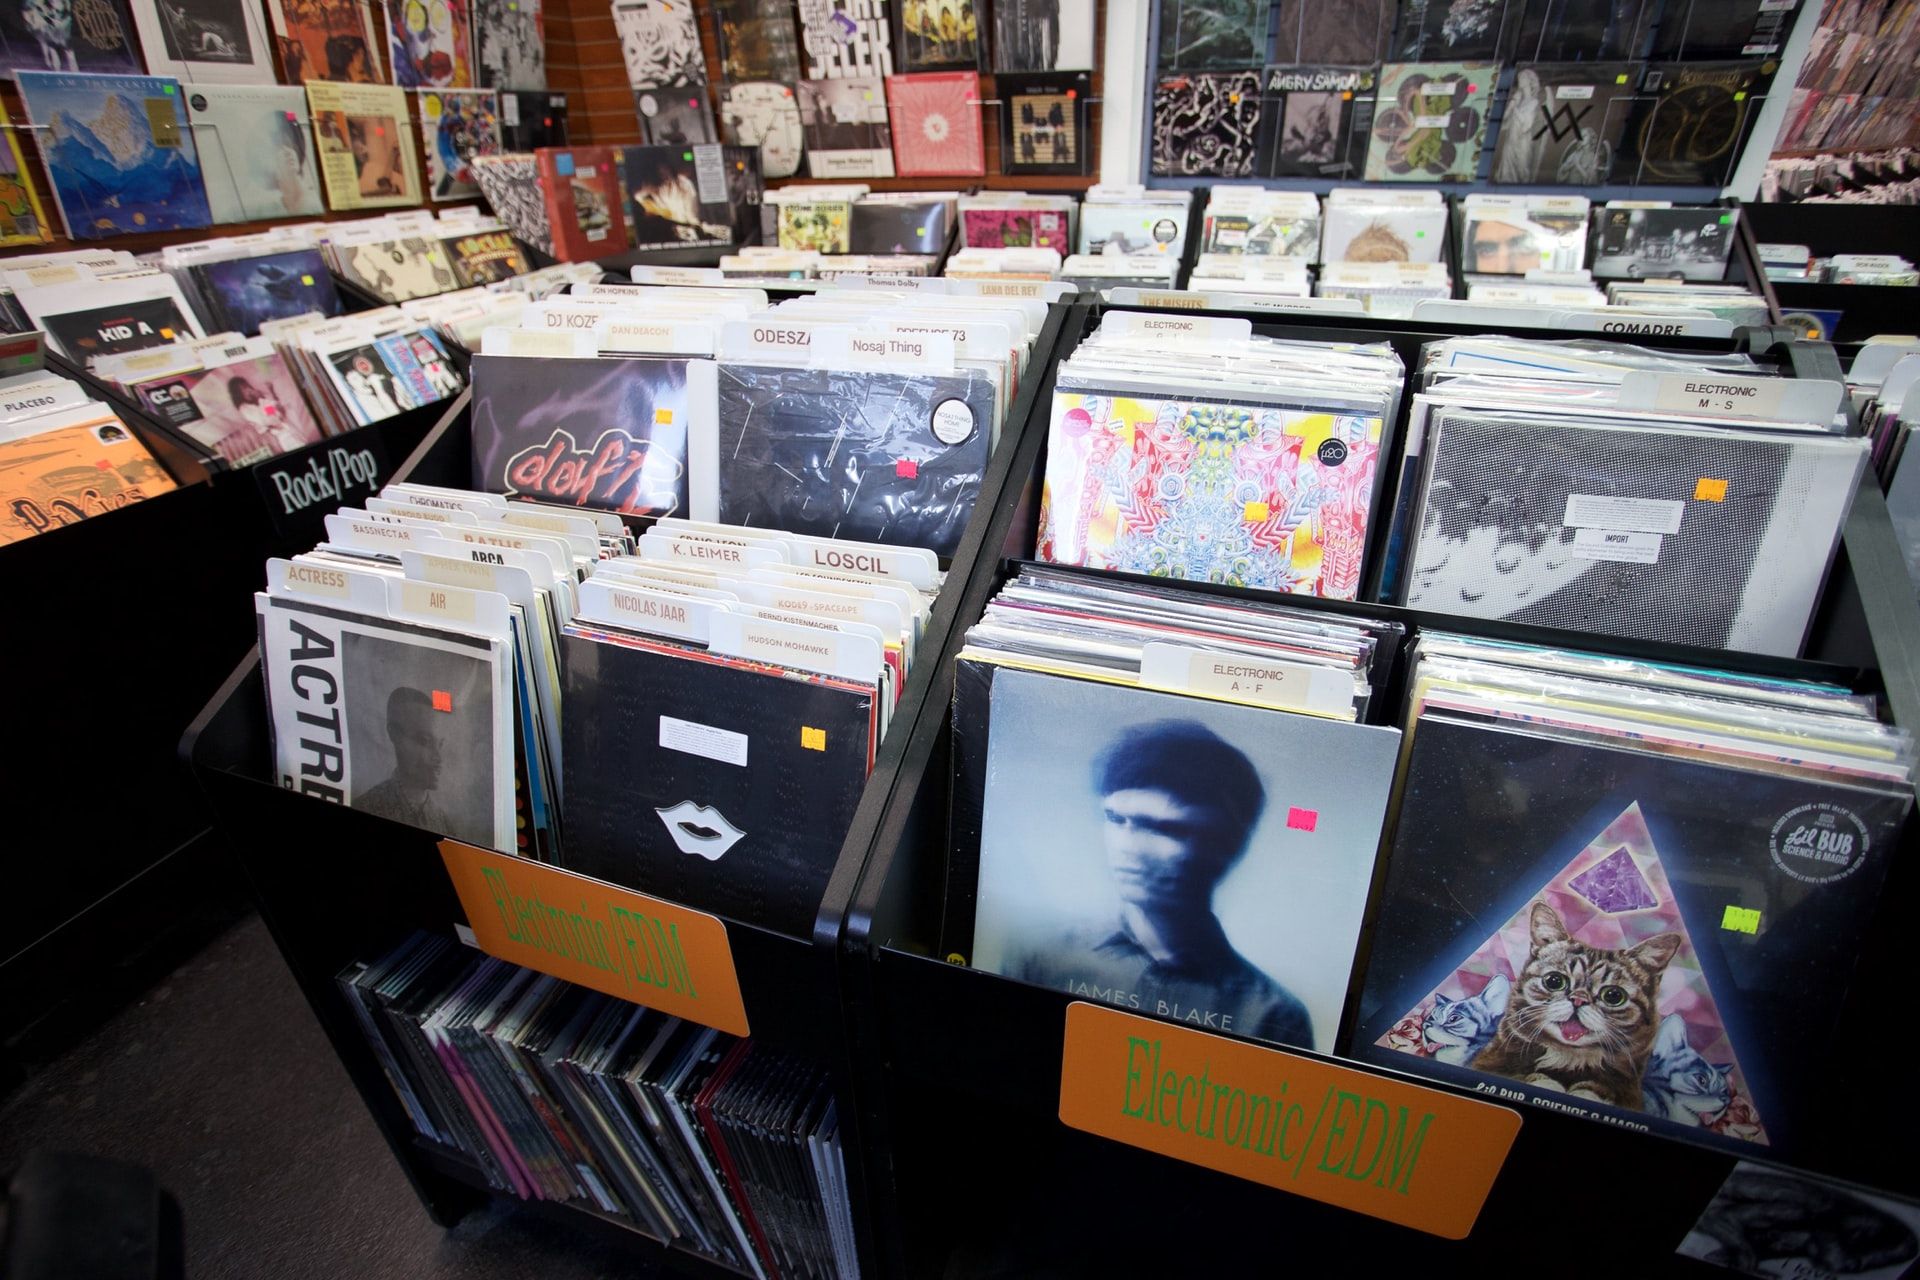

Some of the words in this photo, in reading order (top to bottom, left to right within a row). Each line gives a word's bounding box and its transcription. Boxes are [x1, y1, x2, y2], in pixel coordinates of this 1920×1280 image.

[608, 289, 639, 297] HOPKINS
[868, 279, 896, 287] Thomas
[897, 280, 919, 290] Dolby
[982, 284, 1003, 296] LANA
[1005, 285, 1020, 296] DEL
[1022, 286, 1037, 298] REY
[547, 314, 563, 327] DJ
[1144, 320, 1193, 331] ELECTRONIC
[1603, 322, 1684, 336] COMADRE
[98, 325, 133, 343] KID
[137, 321, 154, 335] A
[611, 326, 630, 336] DAN
[633, 327, 670, 337] DEACON
[852, 339, 886, 355] Nosaj
[889, 340, 922, 357] Thing
[1684, 383, 1758, 398] ELECTRONIC
[4, 396, 56, 413] PLACEBO
[1698, 398, 1710, 409] M
[1724, 399, 1734, 410] S
[271, 446, 378, 515] Rock/Pop
[410, 495, 464, 511] CHROMATICS
[352, 524, 410, 540] BASSNECTAR
[1605, 534, 1630, 543] IMPORT
[472, 550, 505, 565] ARCA
[673, 543, 686, 556] K.
[690, 546, 741, 563] LEIMER
[815, 550, 889, 575] LOSCIL
[288, 565, 345, 588] ACTRESS
[430, 592, 446, 609] AIR
[614, 593, 657, 620] NICOLAS
[660, 603, 686, 624] JAAR
[758, 610, 781, 622] BERND
[783, 616, 839, 631] KISTENMACHER
[748, 635, 783, 648] HUDSON
[785, 642, 830, 656] MOHAWKE
[1213, 664, 1284, 681] ELECTRONIC
[1231, 682, 1240, 691] A
[1256, 684, 1263, 693] F
[1785, 825, 1818, 848] Lil
[1817, 829, 1854, 855] BUB
[1782, 844, 1815, 859] SCIENCE
[1822, 851, 1850, 866] MAGIC
[481, 866, 698, 999] Electronic/EDM
[1155, 999, 1233, 1032] BLAKE
[1121, 1035, 1437, 1197] Electronic/EDM
